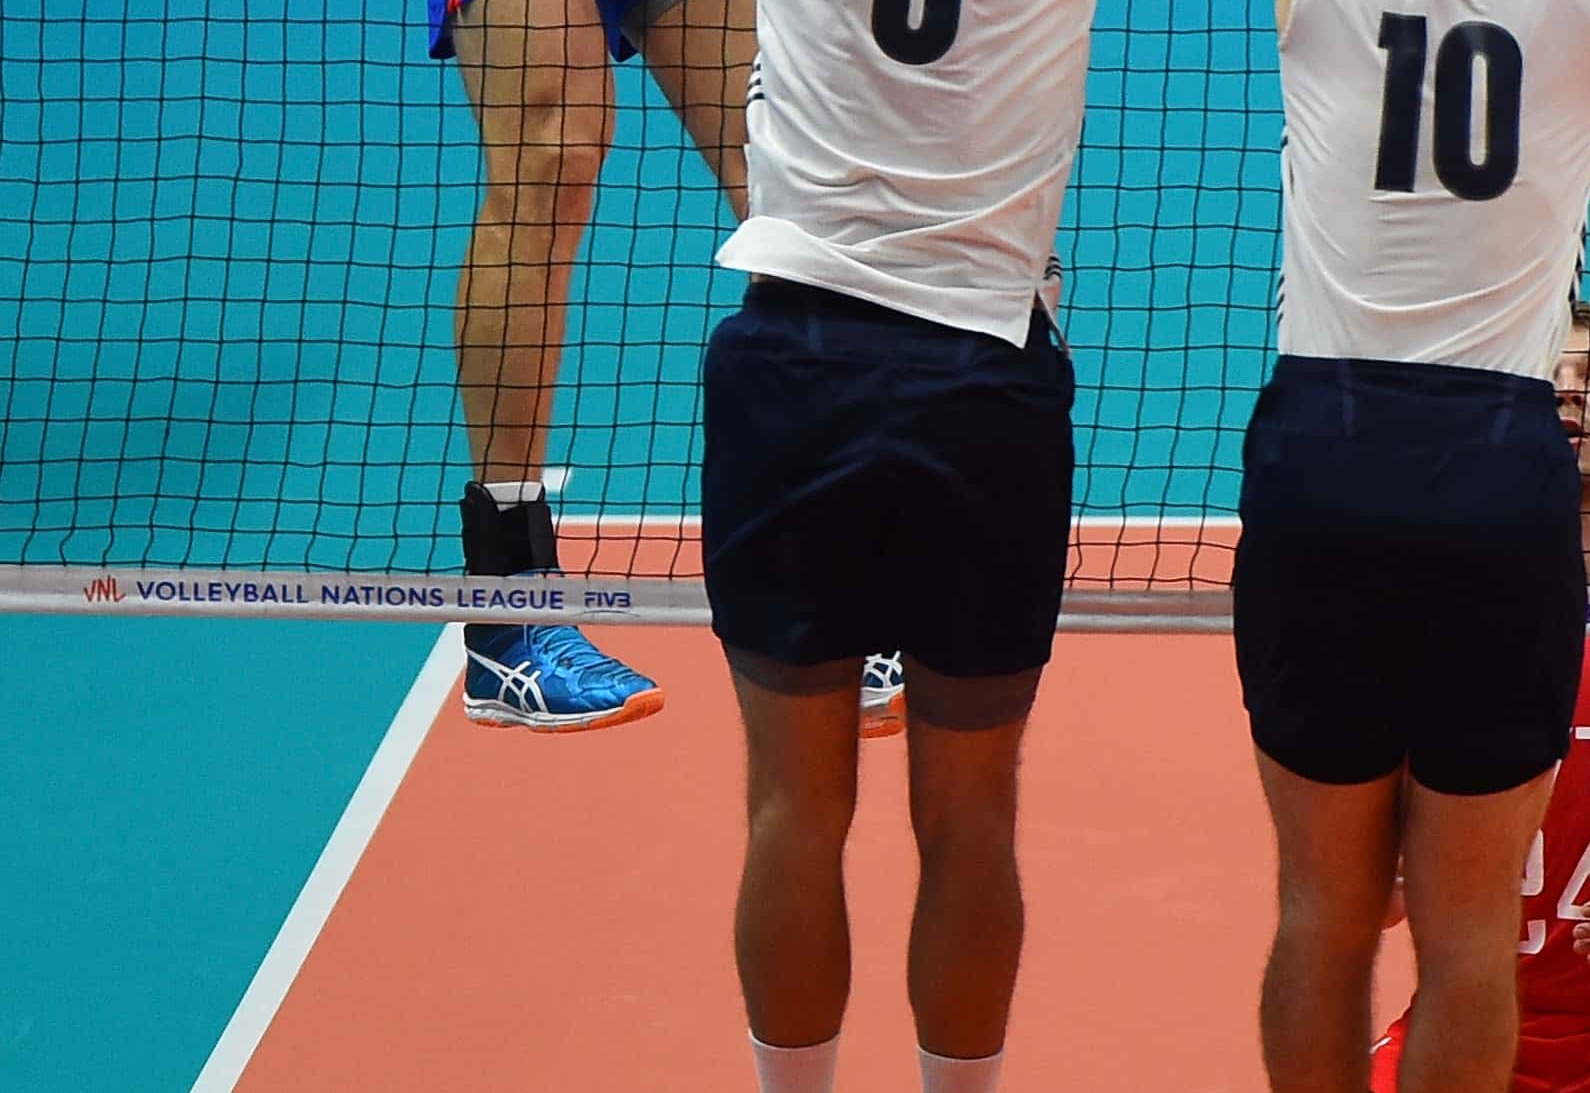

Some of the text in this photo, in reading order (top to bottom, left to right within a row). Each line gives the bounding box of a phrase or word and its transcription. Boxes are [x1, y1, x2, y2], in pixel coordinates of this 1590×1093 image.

[1375, 11, 1523, 201] 10
[84, 575, 126, 602] VNL
[137, 581, 309, 603] VOLLEYBALL
[321, 586, 444, 606] NATIONS
[457, 589, 564, 609] LEAGUE
